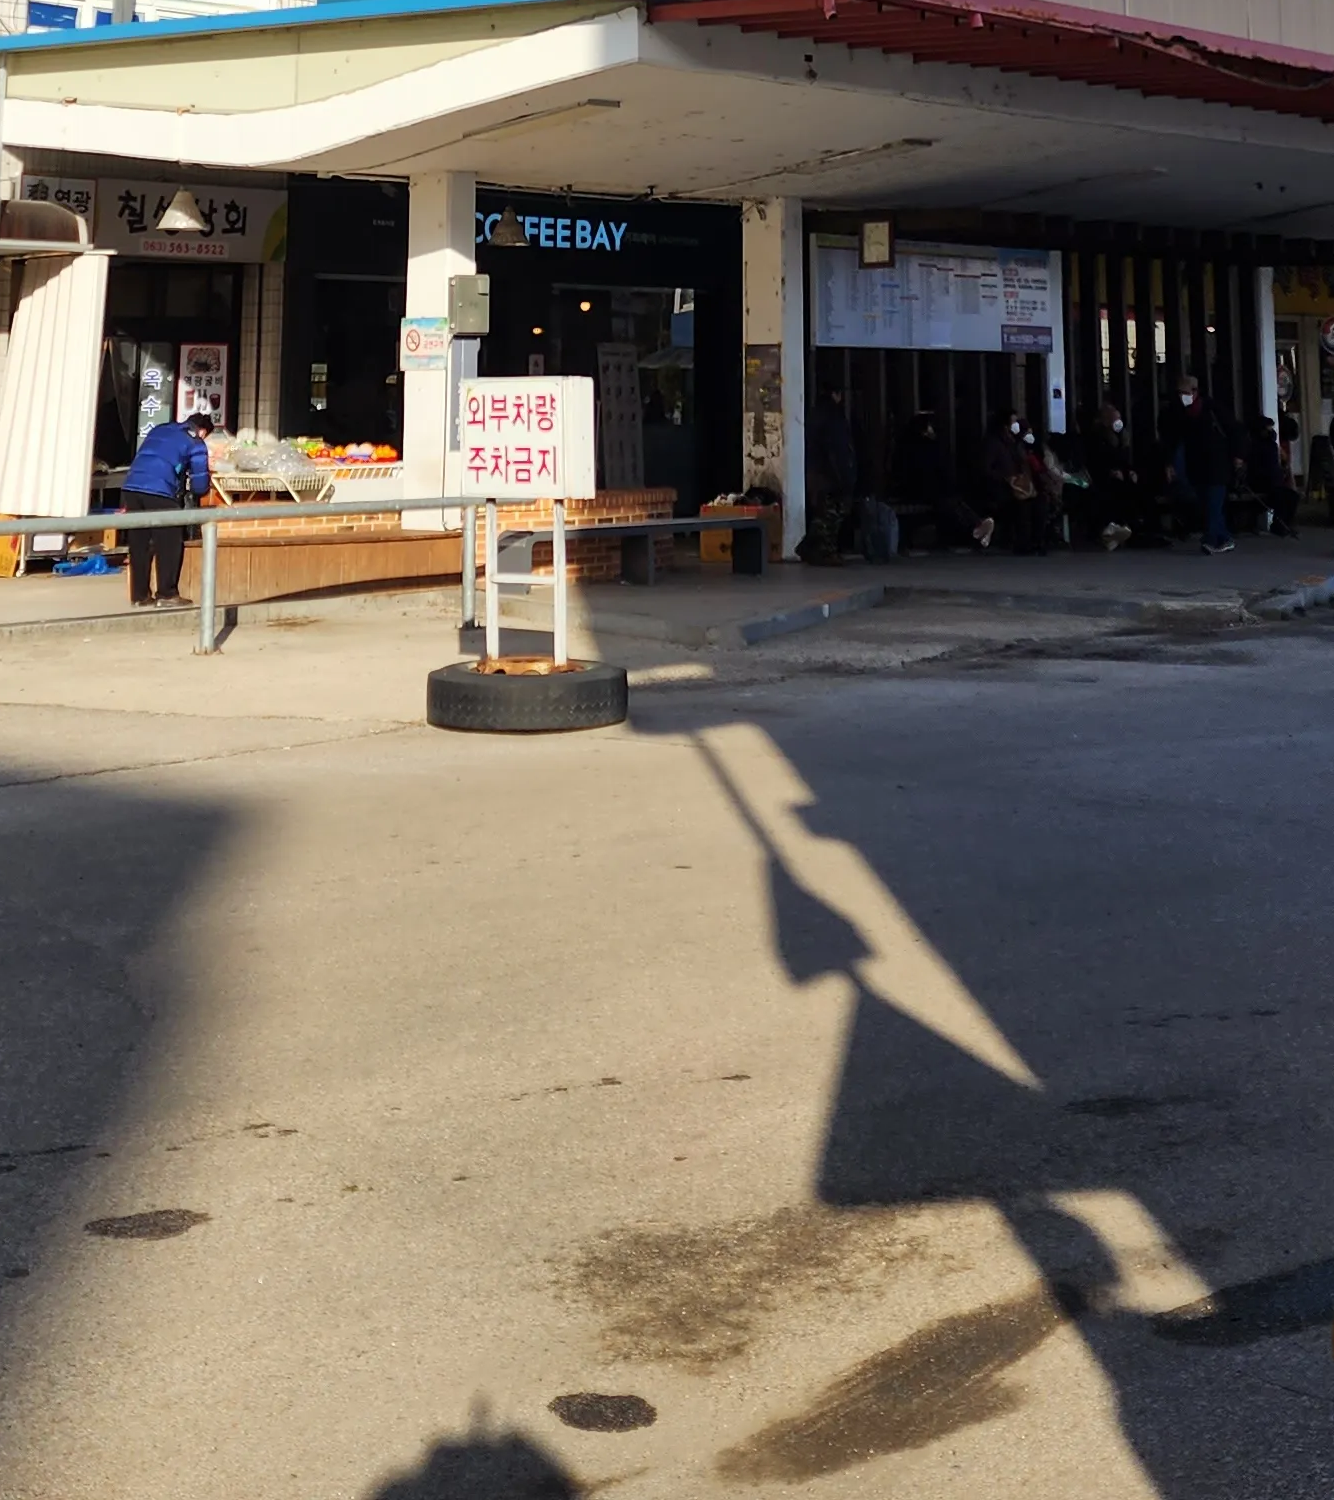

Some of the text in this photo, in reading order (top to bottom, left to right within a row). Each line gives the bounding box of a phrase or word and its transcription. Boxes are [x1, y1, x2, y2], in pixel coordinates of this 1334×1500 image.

[474, 211, 628, 253] COFEE BAY
[466, 393, 558, 432] 외부차량
[466, 445, 558, 485] 주차금지
